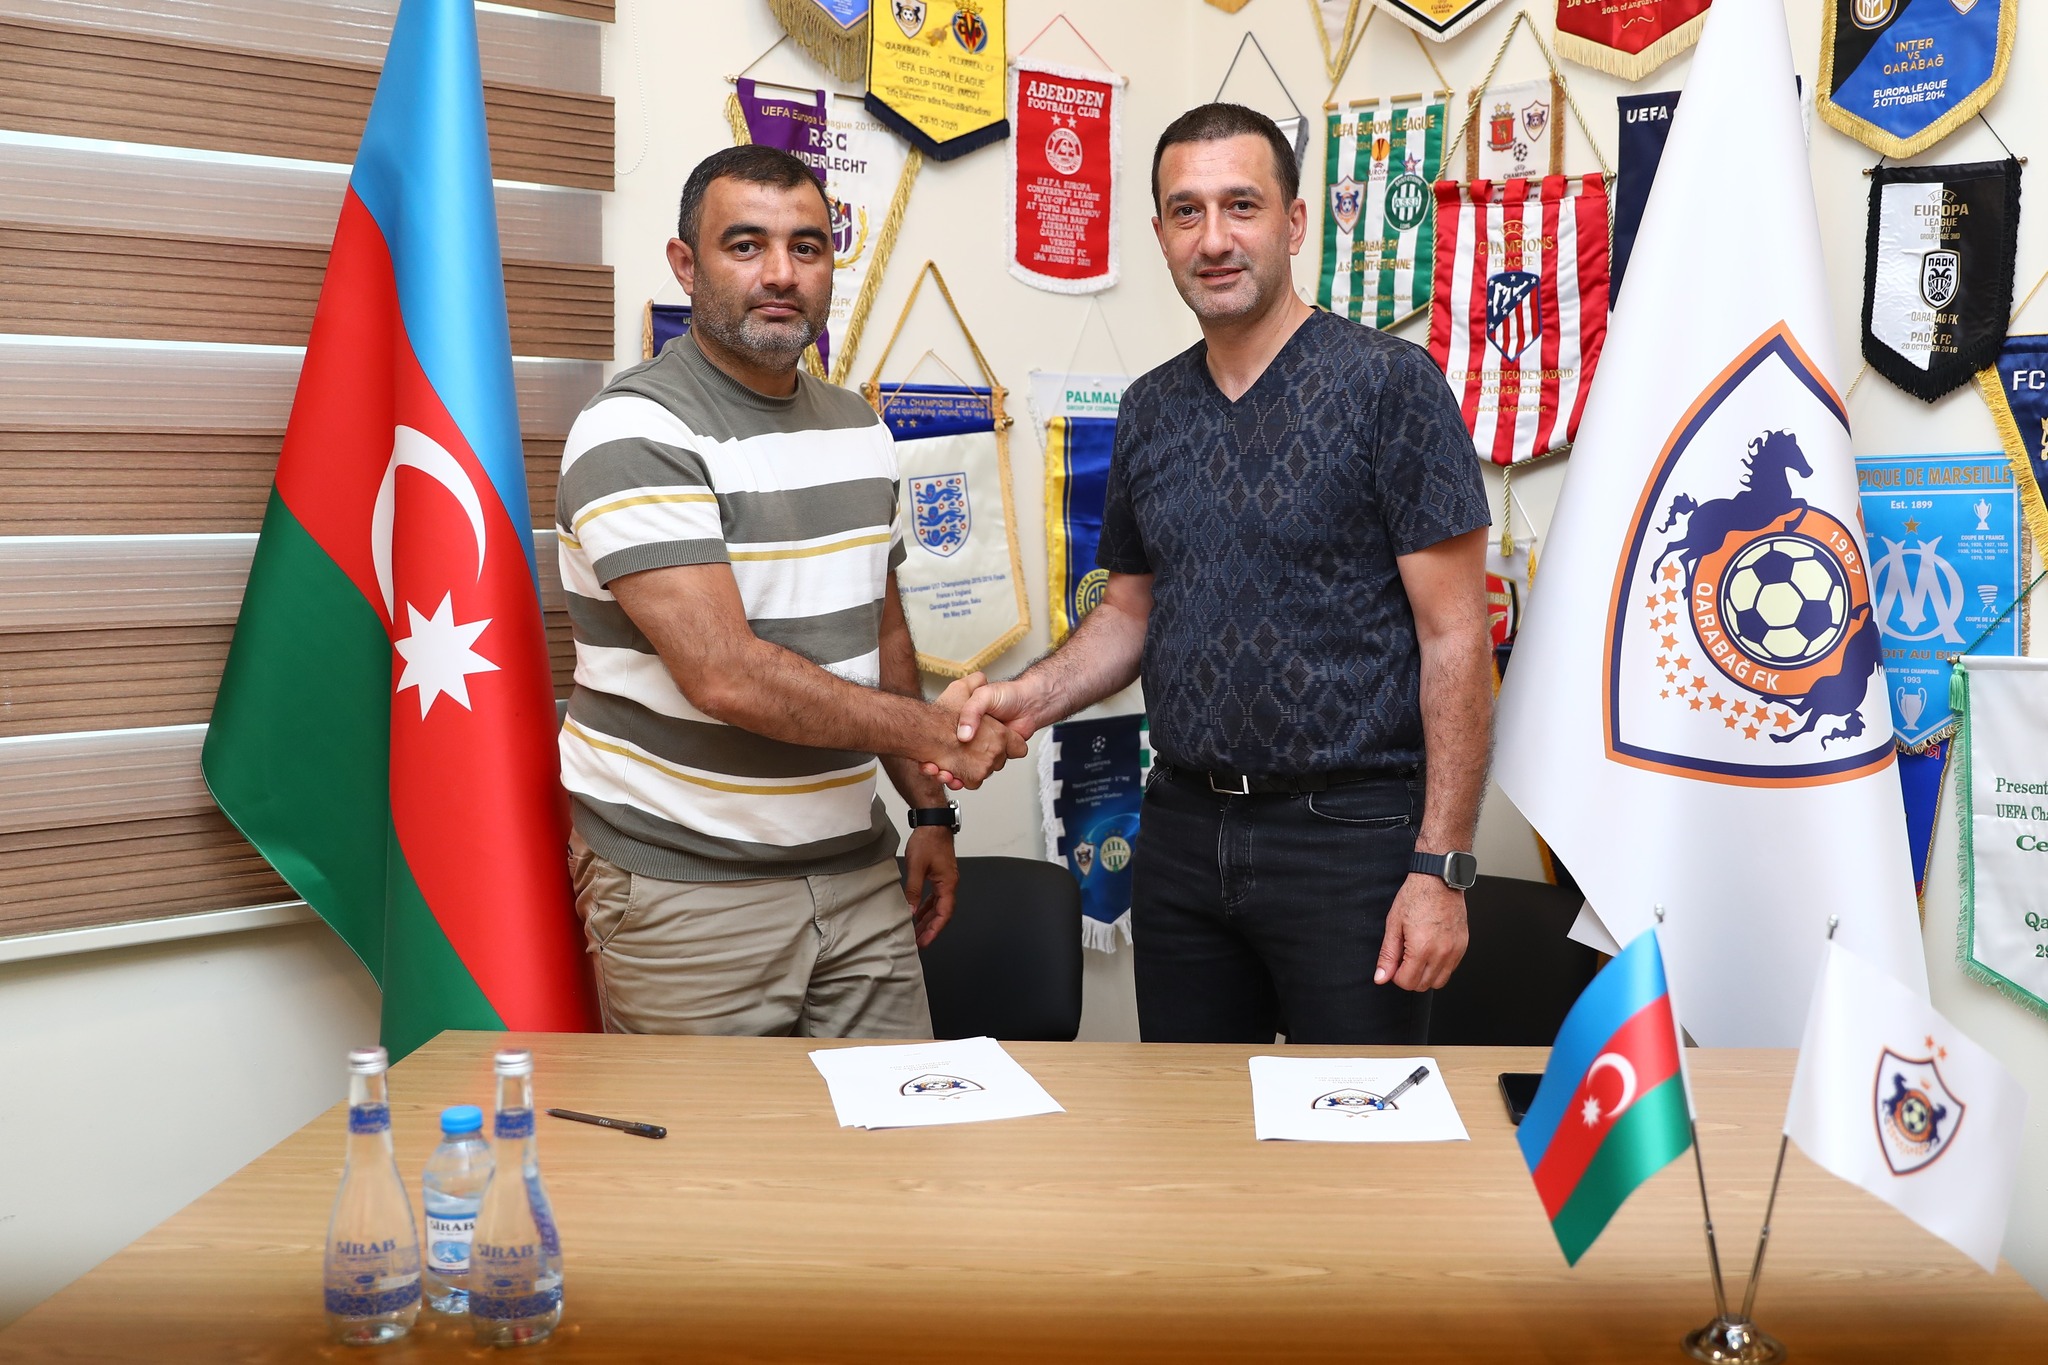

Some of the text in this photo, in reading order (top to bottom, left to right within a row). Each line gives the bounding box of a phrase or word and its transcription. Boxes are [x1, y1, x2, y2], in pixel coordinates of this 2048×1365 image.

[1895, 37, 1934, 53] INTER
[1907, 51, 1920, 60] VS
[1883, 54, 1944, 75] QARABAĞ
[896, 61, 986, 88] UEFA EUROPA LEAGUE
[903, 76, 930, 89] GROUP
[932, 82, 955, 94] STAGE
[1873, 80, 1948, 99] EUROPA LEAGUE
[1027, 81, 1105, 108] ABERDEEN
[1872, 91, 1946, 108] 2 OTTOBRE 2014
[1028, 97, 1101, 119] FOOTBALL CLUB
[1626, 106, 1668, 124] UEFA
[762, 105, 892, 133] UEFA Europa League 2015/20
[1332, 115, 1435, 138] UEFA EUROPA LEAGUE
[808, 127, 848, 152] RSC
[1503, 170, 1536, 180] CHAMPIONS
[1930, 191, 1955, 203] UEFA
[1026, 201, 1037, 210] AT
[1914, 203, 1969, 217] EUROPA
[1924, 218, 1958, 227] LEAGUE
[1478, 236, 1554, 255] CHAMPIONS
[1494, 255, 1533, 268] LEAGUE
[1911, 311, 1959, 325] QARABAG FK
[1901, 342, 1910, 350] 20
[1911, 332, 1952, 345] PAOK FC
[1451, 370, 1476, 382] CLUB
[1521, 370, 1537, 380] DE
[1537, 368, 1574, 380] MADRID
[2012, 370, 2046, 391] FC
[910, 398, 954, 408] CHAMPIONS
[956, 400, 985, 411] LEAGUE
[1905, 469, 1924, 488] DE
[1928, 465, 2011, 488] MARSEILLE
[1891, 500, 1933, 510] Est. 1899
[1829, 531, 1862, 576] 1987
[1696, 583, 1780, 691] QARABAĞ FK
[1909, 649, 1931, 660] AU
[1903, 676, 1921, 684] 1993
[1996, 804, 2028, 820] UEFA
